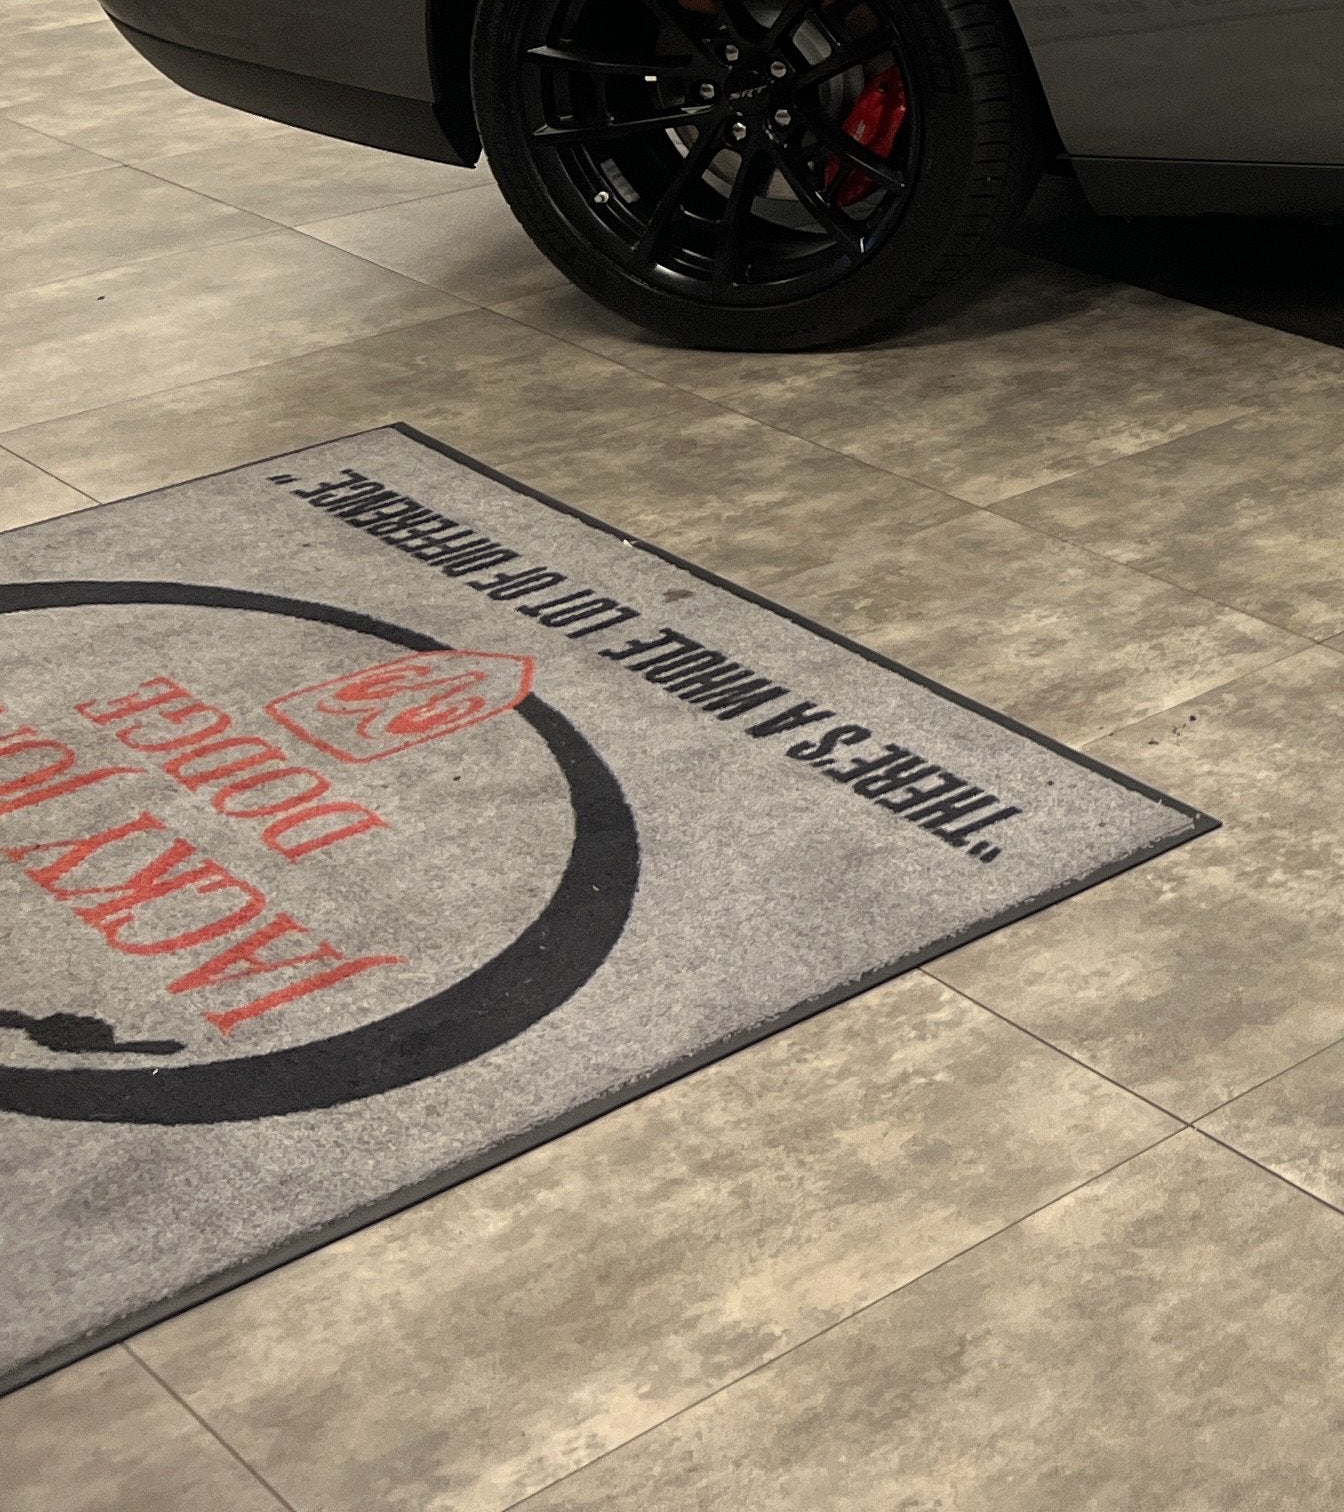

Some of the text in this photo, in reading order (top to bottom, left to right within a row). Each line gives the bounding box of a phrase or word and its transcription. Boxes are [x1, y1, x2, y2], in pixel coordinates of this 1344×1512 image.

[465, 566, 568, 602] OF
[514, 588, 641, 639] LOT
[598, 627, 791, 721] WHOLE
[744, 699, 836, 739] A
[74, 675, 392, 864] DODGE
[3, 810, 410, 1038] JACKY
